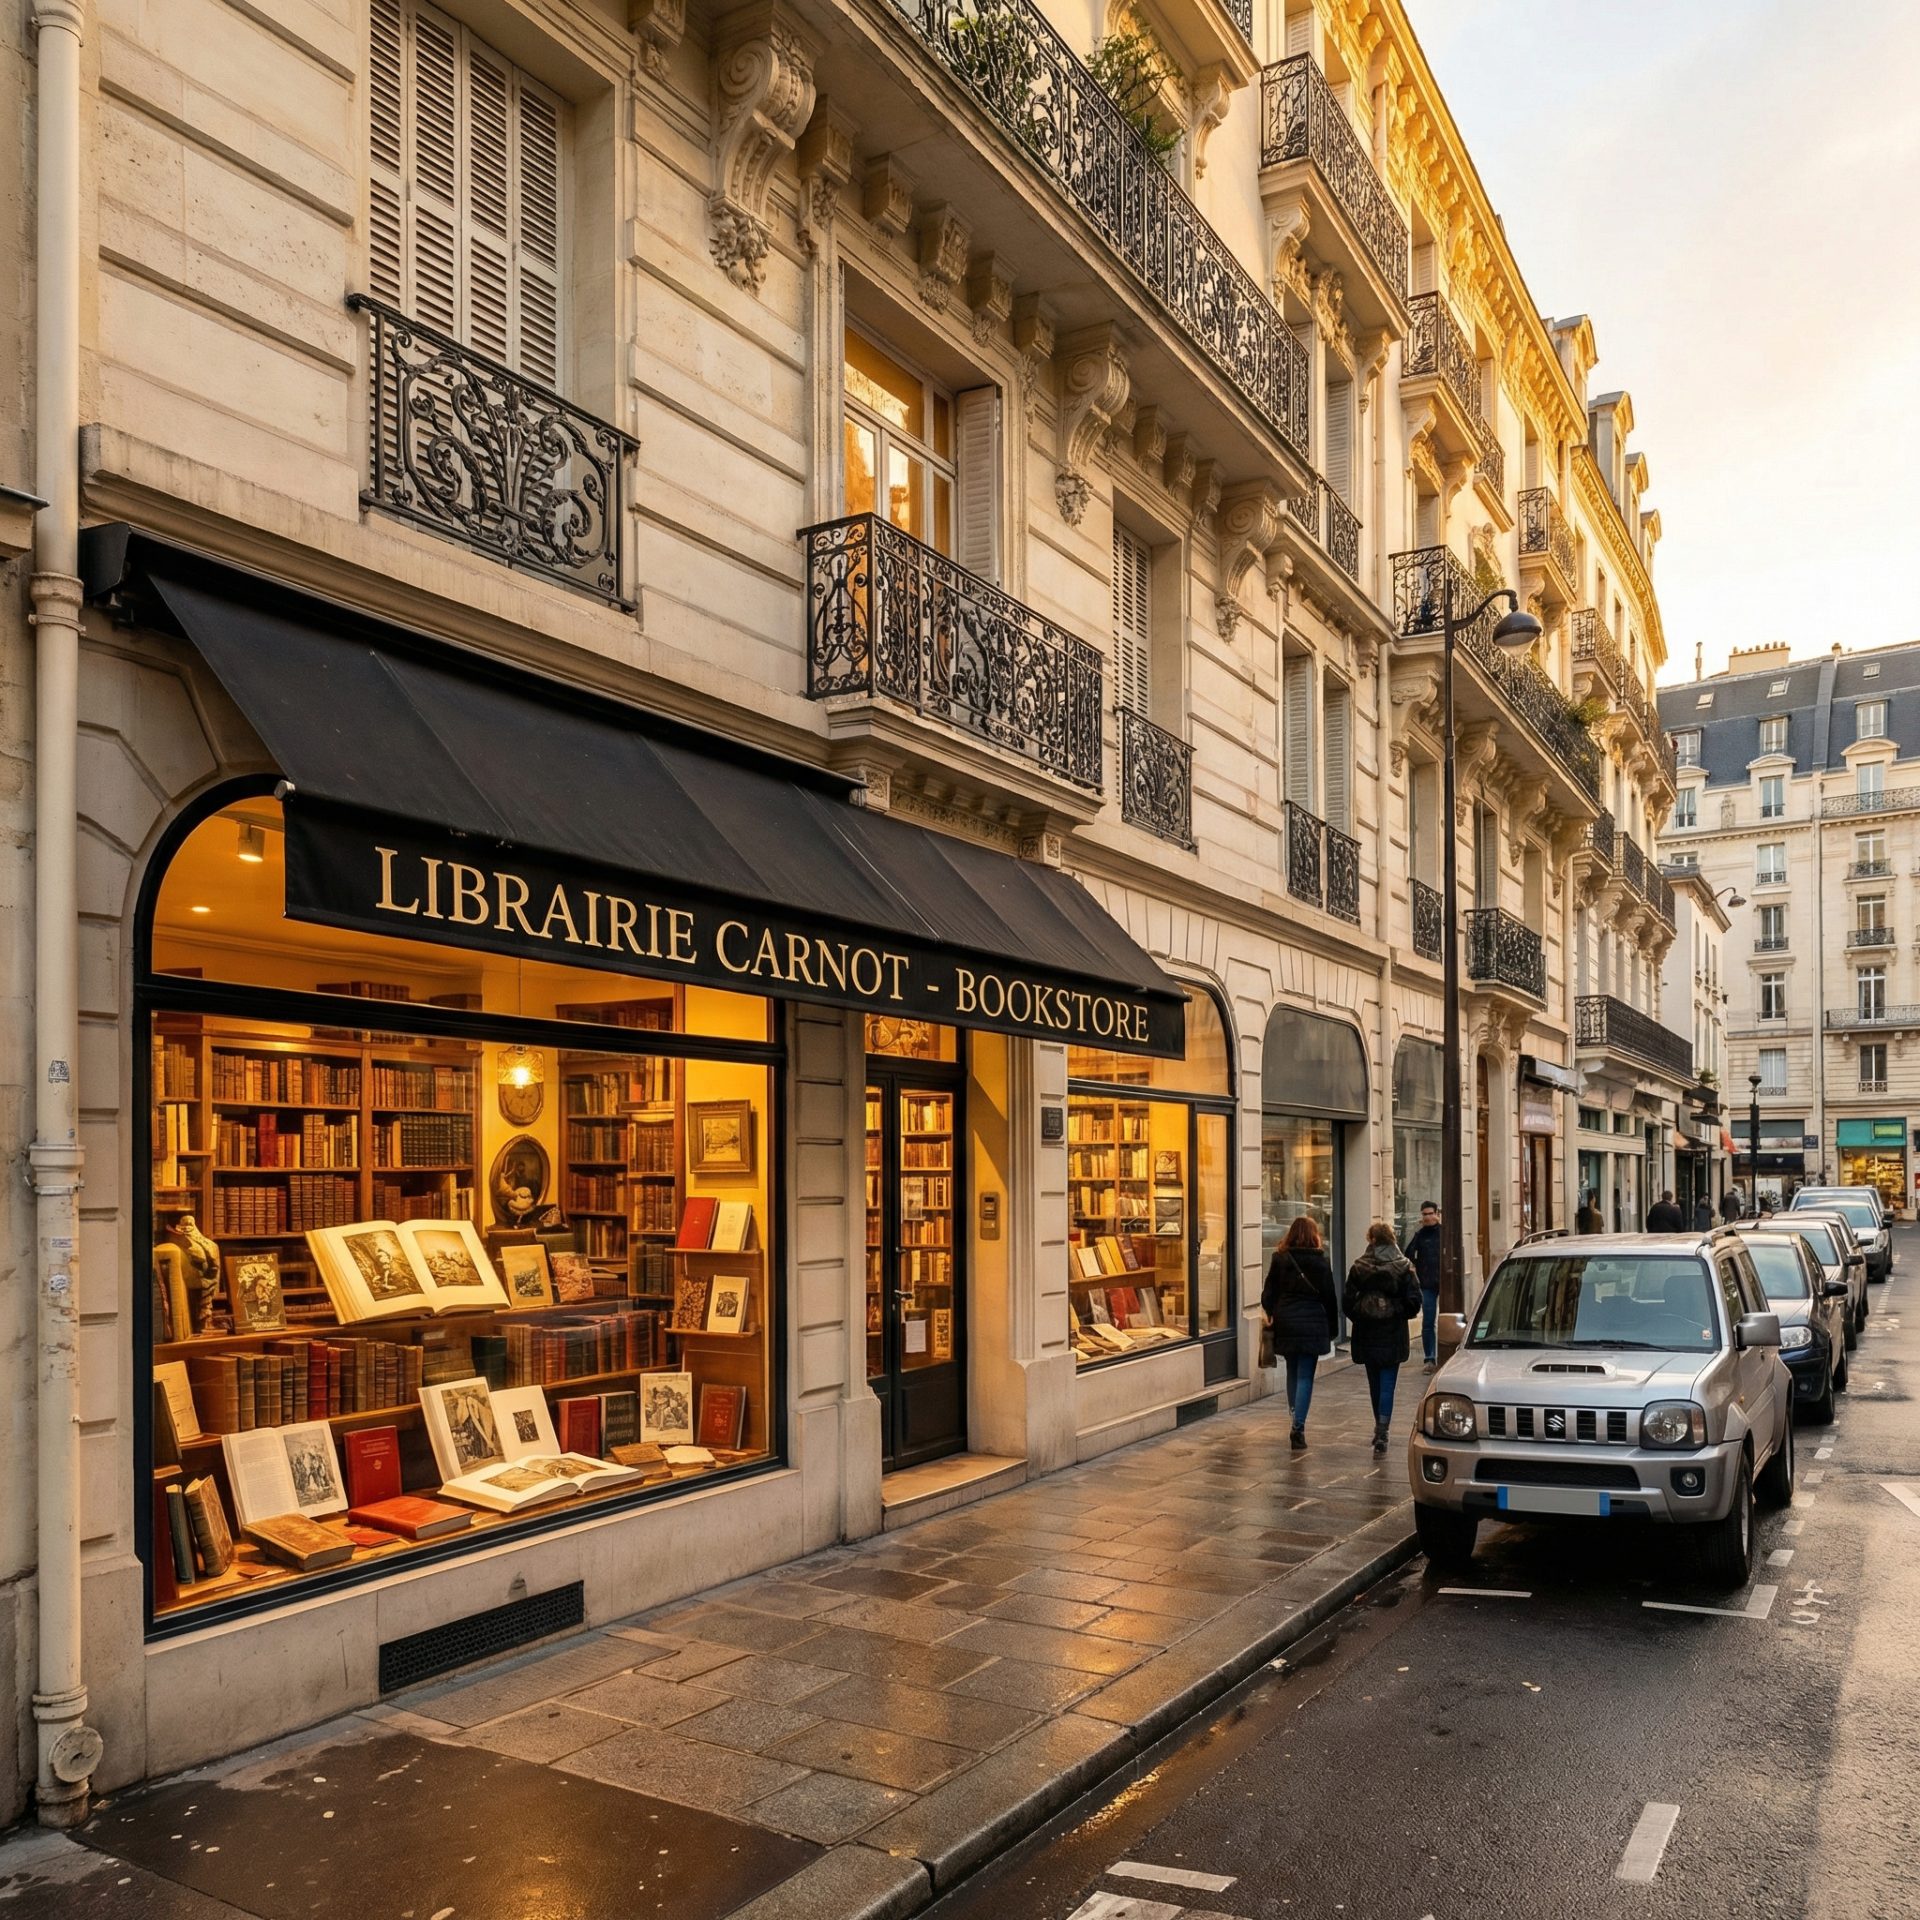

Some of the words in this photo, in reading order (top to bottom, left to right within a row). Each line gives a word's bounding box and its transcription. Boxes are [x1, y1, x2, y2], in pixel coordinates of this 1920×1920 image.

[374, 846, 698, 965] LIBRAIRIE
[715, 920, 909, 1001] CARNOT
[926, 984, 940, 993] -
[955, 967, 1150, 1043] BOOKSTORE
